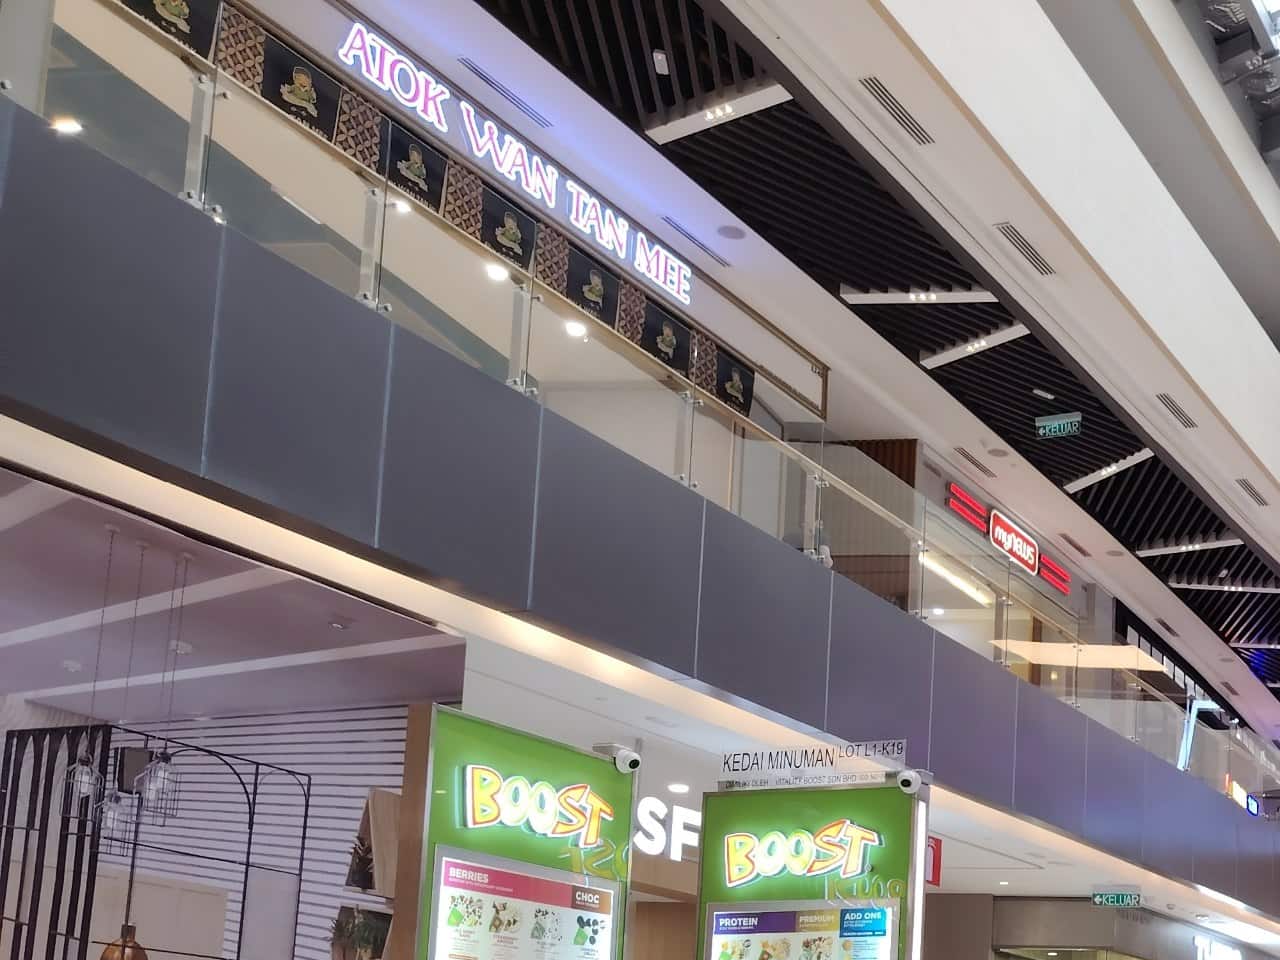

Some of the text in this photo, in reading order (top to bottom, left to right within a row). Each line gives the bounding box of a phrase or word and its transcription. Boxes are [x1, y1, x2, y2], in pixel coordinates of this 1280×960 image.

[339, 22, 692, 305] ATOK WAN TAN MEE
[1045, 421, 1079, 438] KELUAR
[723, 742, 903, 773] KEDAI MINUMAN LOT L1-K19
[803, 775, 826, 785] BOOST
[842, 774, 857, 783] BHD
[465, 764, 615, 849] BOOST
[633, 796, 702, 863] SF
[724, 818, 880, 888] BOOST
[449, 866, 489, 884] BERRIES
[575, 890, 600, 904] CHOC
[1102, 895, 1139, 907] KELUAR
[719, 917, 759, 927] PROTEIN
[844, 911, 882, 921] ADD ONE
